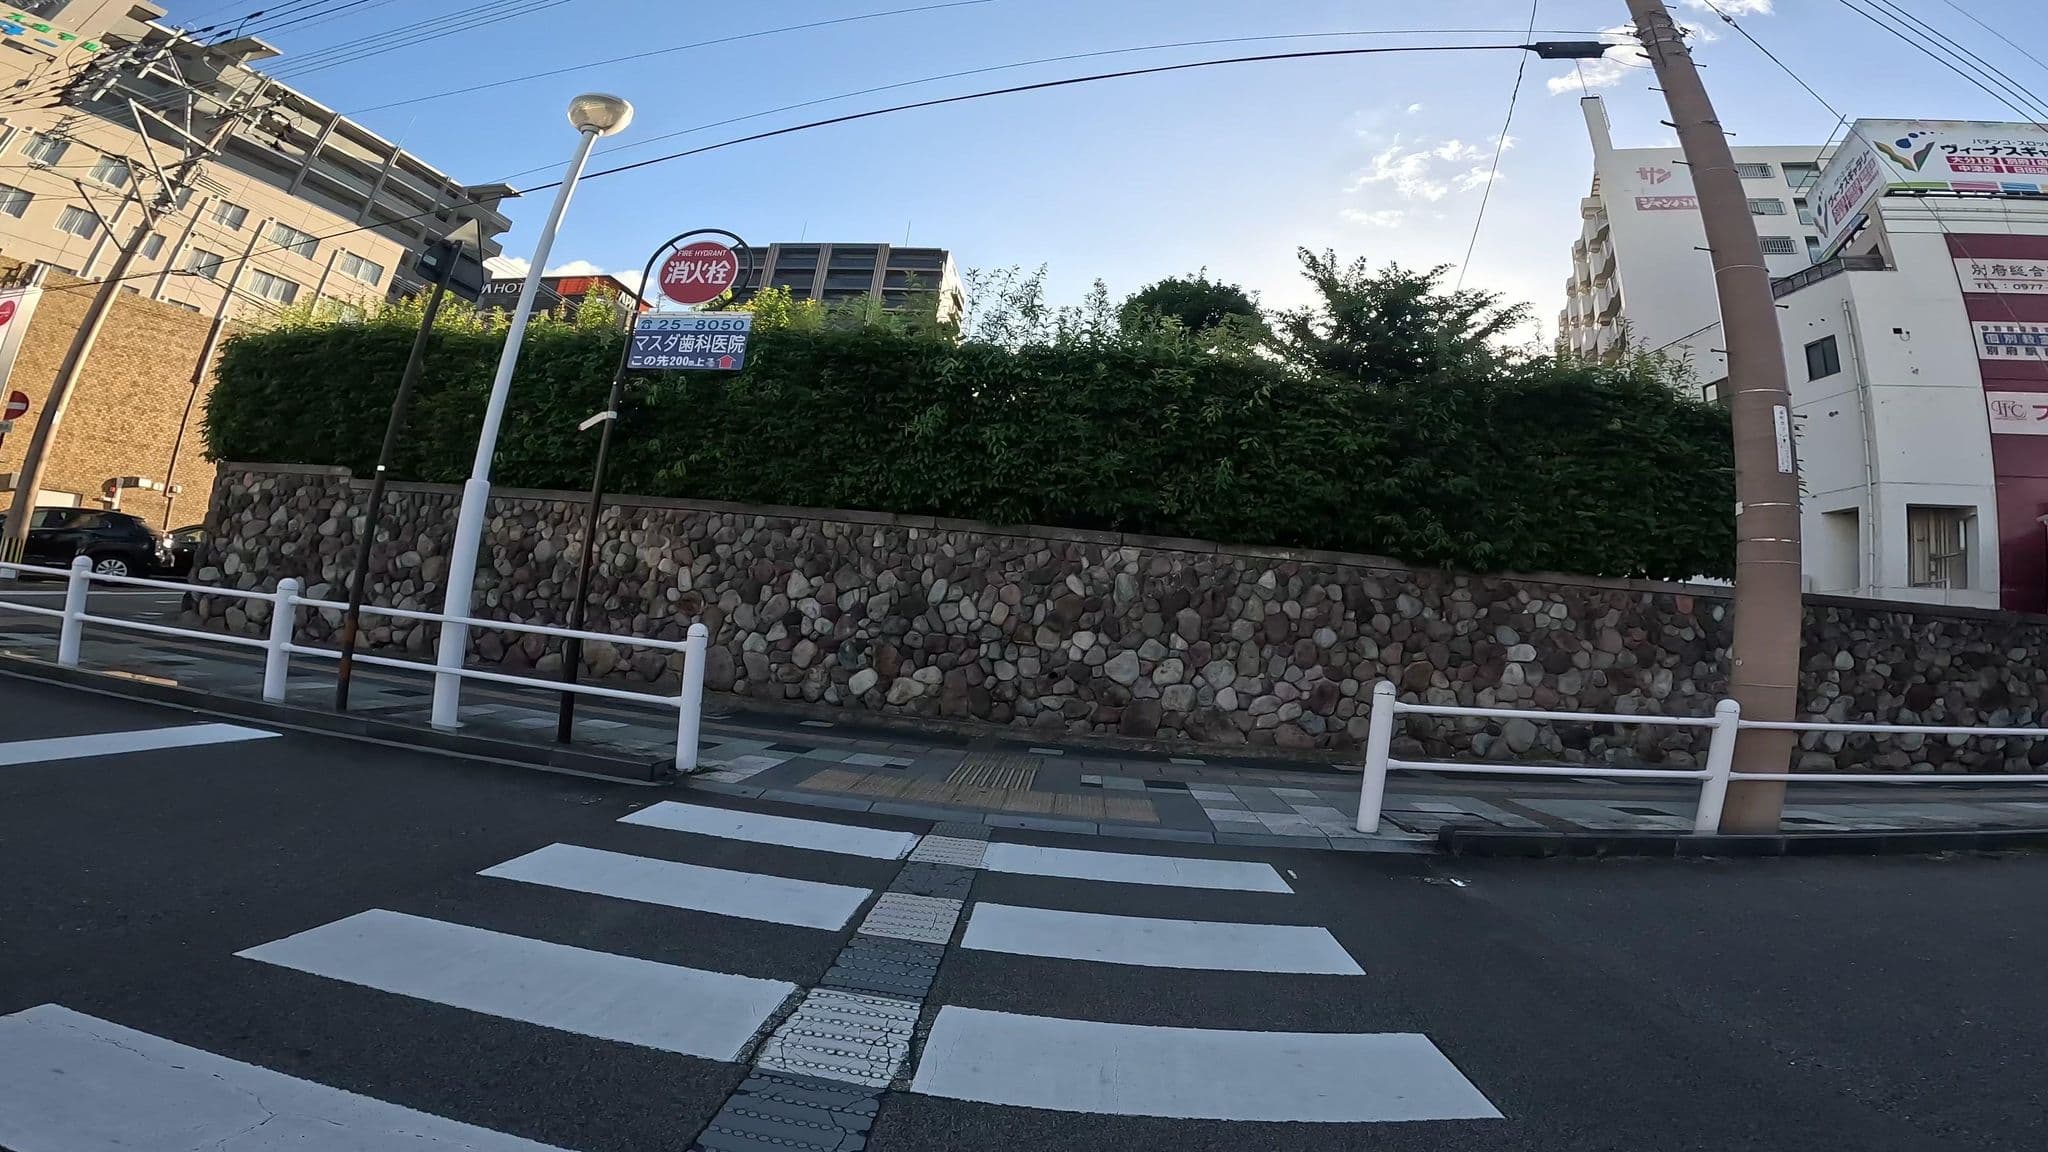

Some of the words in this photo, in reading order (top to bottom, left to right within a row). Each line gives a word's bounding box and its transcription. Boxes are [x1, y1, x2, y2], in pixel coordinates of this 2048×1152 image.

[694, 249, 727, 257] HYDRANT
[664, 260, 731, 285] 消火栓
[634, 333, 746, 354] マスダ歯科医院
